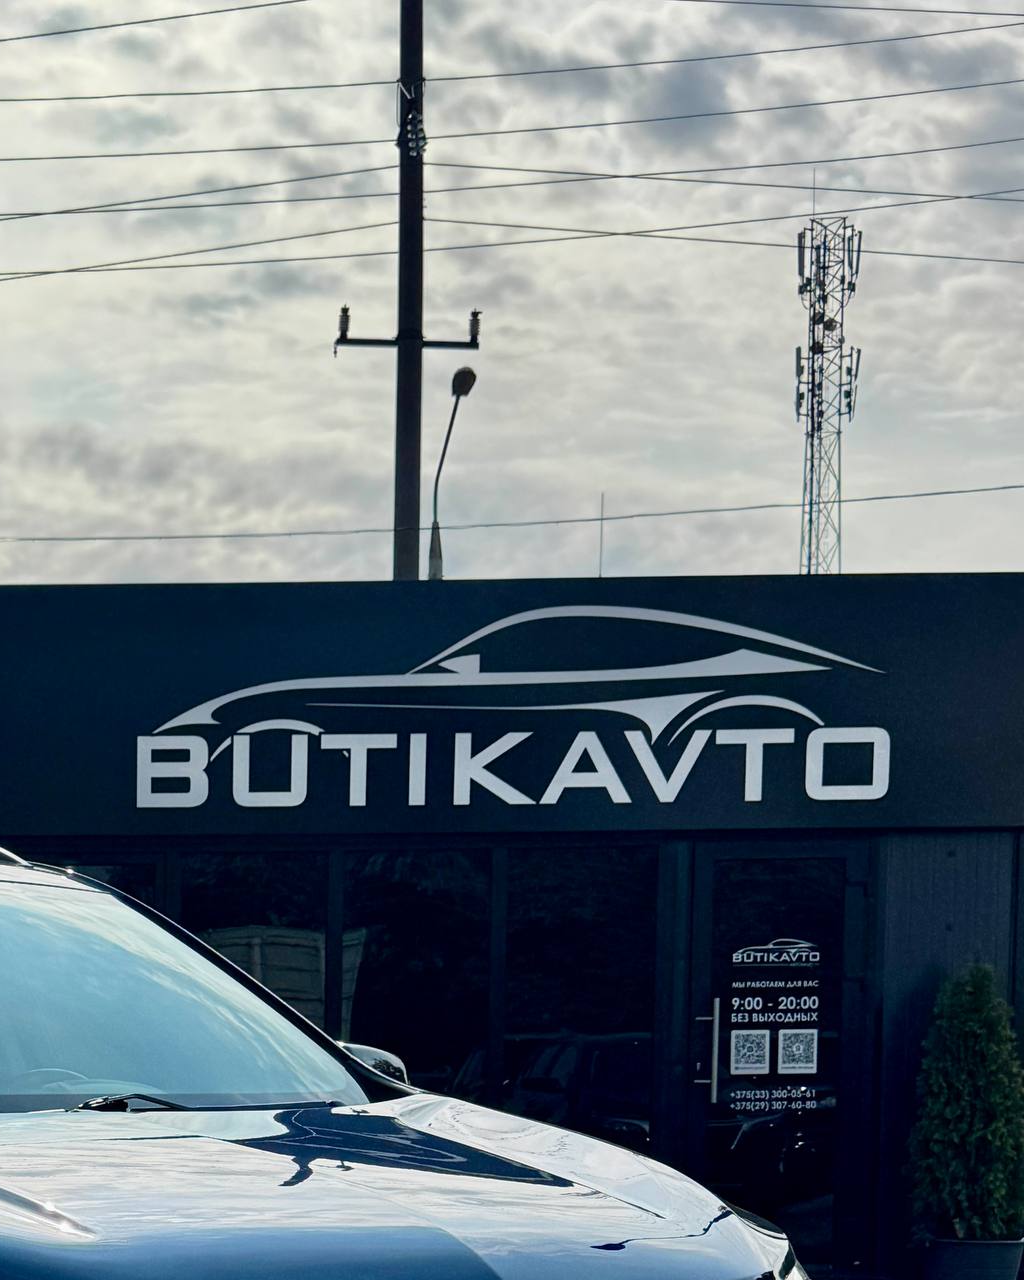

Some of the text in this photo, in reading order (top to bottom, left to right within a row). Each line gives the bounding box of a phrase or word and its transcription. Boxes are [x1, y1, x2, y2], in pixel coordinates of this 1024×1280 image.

[136, 726, 891, 808] BUTIKAVTO
[731, 951, 820, 963] BUTIKAVTO
[731, 980, 820, 989] МЫ РАБОТАЕМ ДЛЯ ВАС
[731, 996, 763, 1011] 9:00
[778, 995, 819, 1010] 20:00
[731, 1011, 818, 1023] БЕЗ ВЫХОДНЫХ
[730, 1100, 770, 1112] +375(29)
